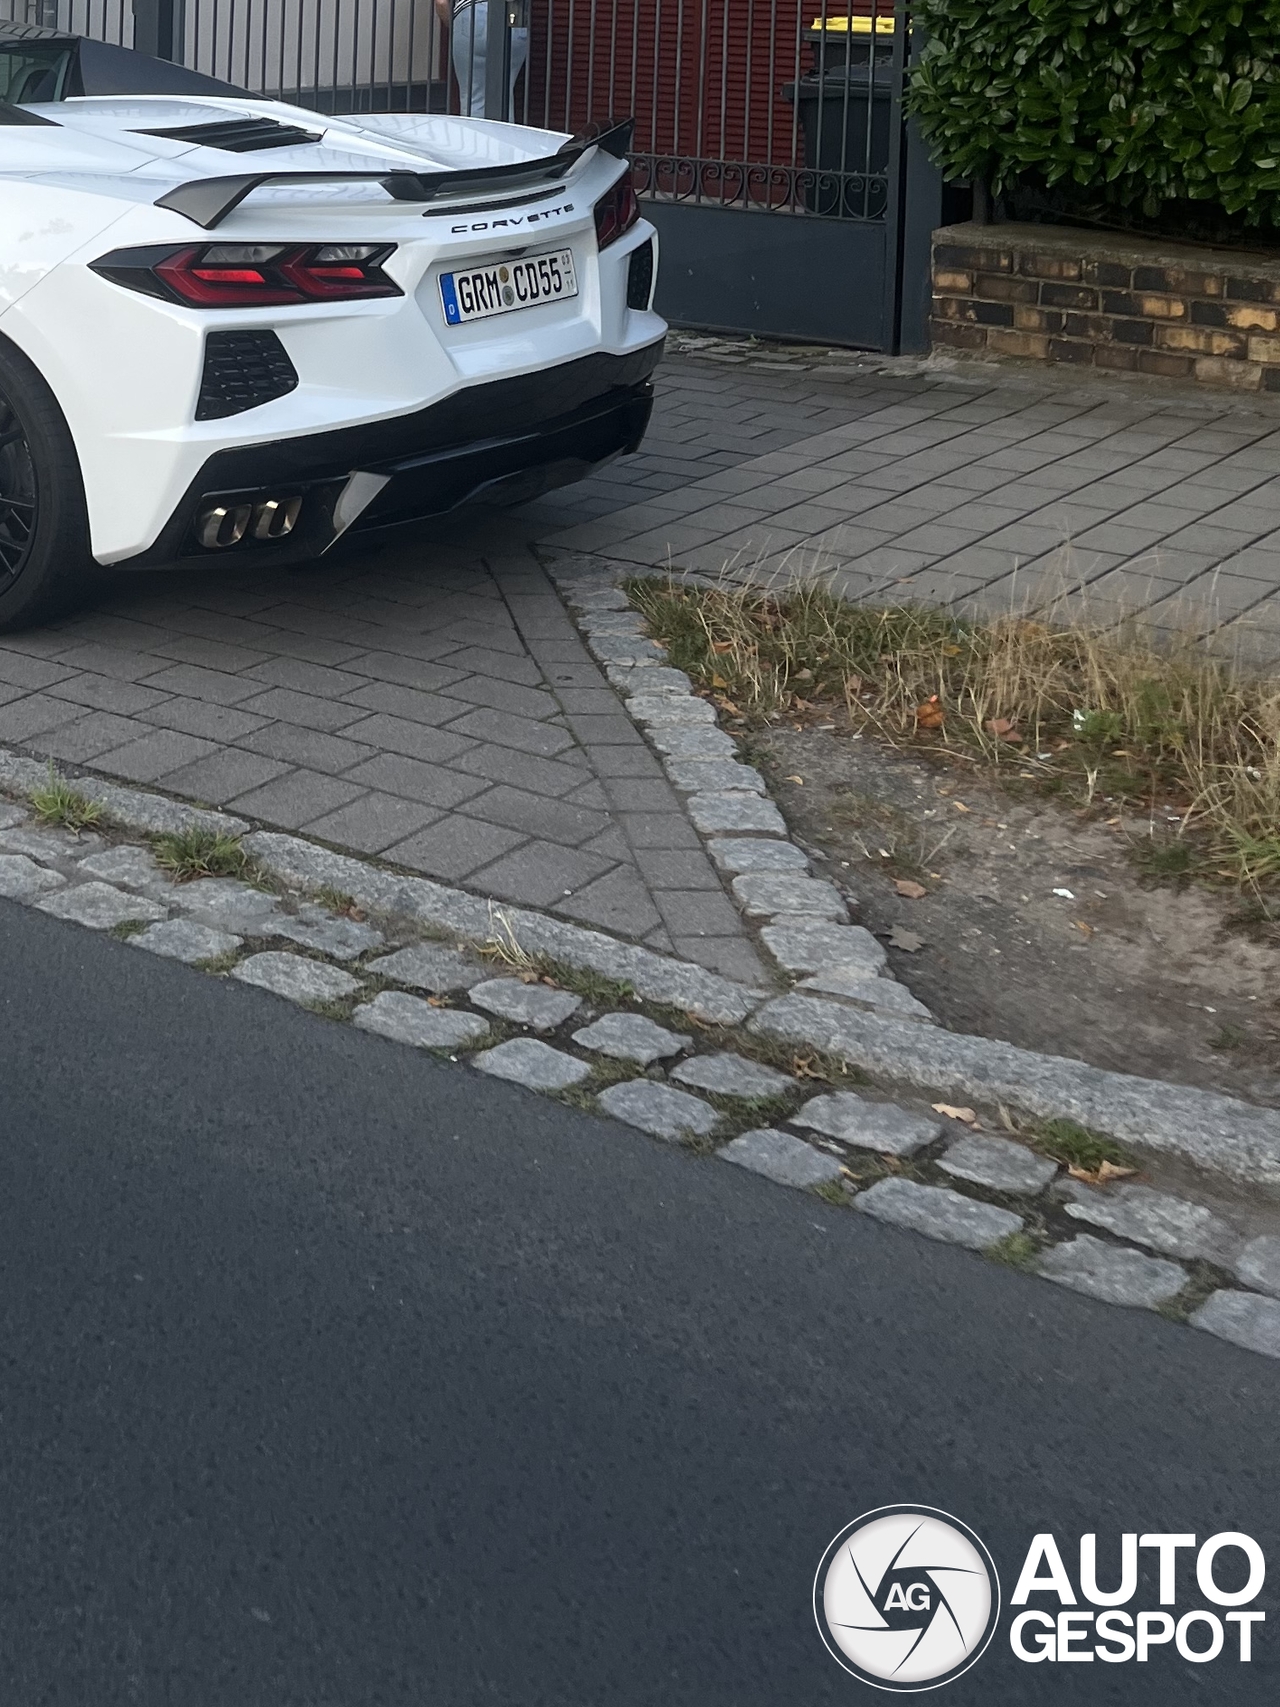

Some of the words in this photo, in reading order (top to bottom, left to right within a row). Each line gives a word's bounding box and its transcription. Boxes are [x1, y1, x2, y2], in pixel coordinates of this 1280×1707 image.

[451, 203, 575, 234] CORVETTE
[458, 270, 502, 314] GRM
[513, 257, 563, 302] CD55
